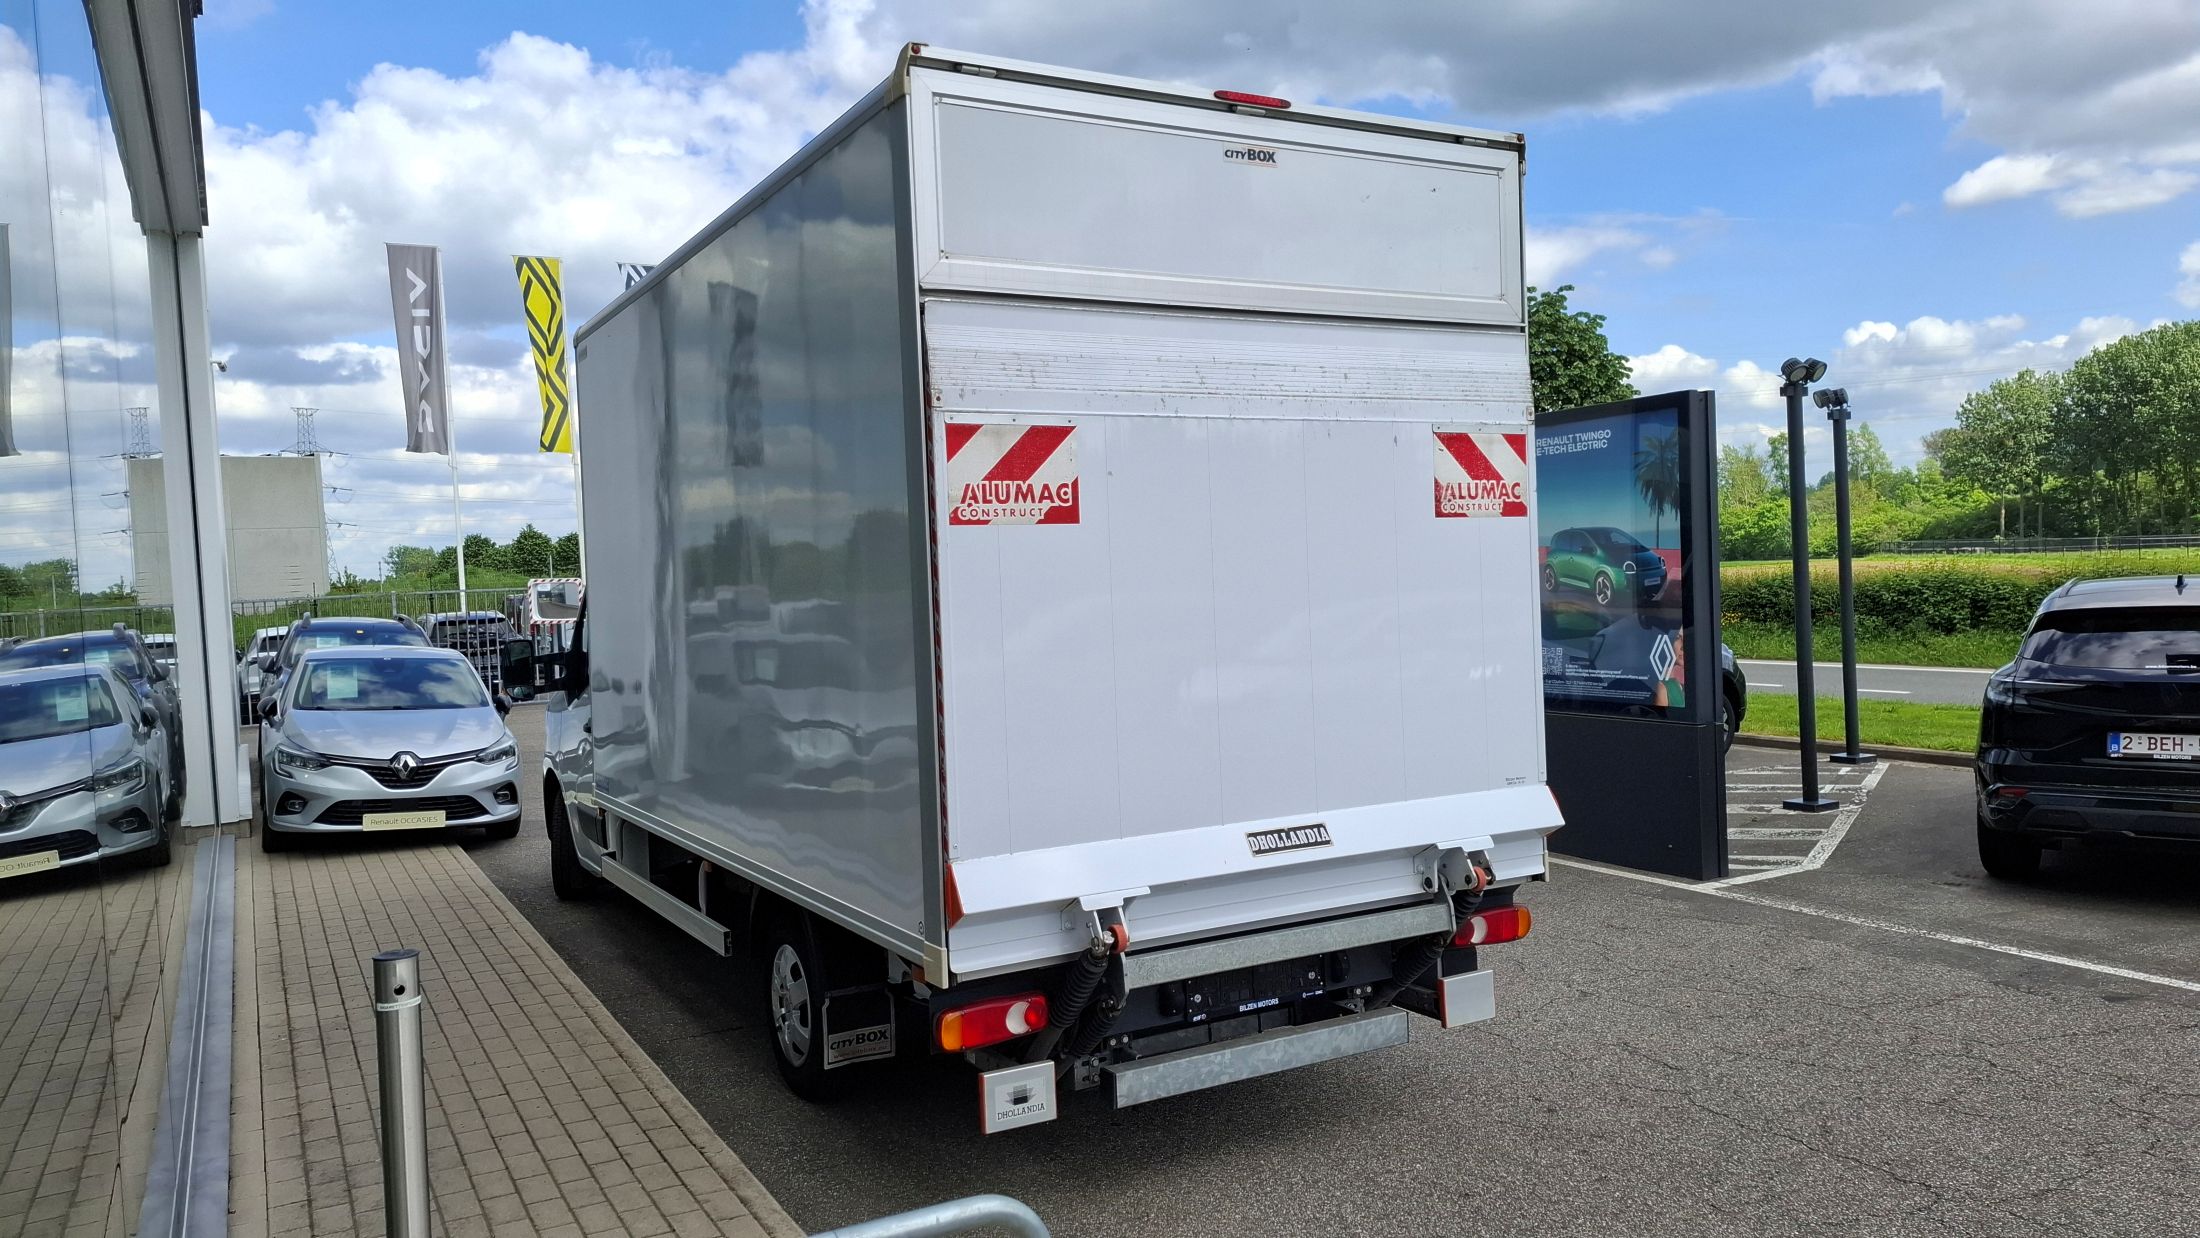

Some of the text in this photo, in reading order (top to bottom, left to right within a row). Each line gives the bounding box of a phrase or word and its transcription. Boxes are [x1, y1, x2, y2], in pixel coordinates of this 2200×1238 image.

[1536, 429, 1612, 448] RENAULT TWINGO
[1536, 439, 1608, 457] E-TECH ELECTRIC
[960, 482, 1071, 505] ALUMAC
[1442, 482, 1521, 500] ALUMAC
[960, 507, 1044, 518] CONSTRUCT
[1442, 502, 1502, 511] CONSTRUCT
[2122, 735, 2200, 752] 2-BEH-
[370, 816, 438, 826] Renault OCCASIES
[1247, 826, 1330, 851] DHOLLANDIA
[1239, 997, 1279, 1012] BILZEN MOTORS
[997, 1103, 1046, 1121] DHOLLANDIA
